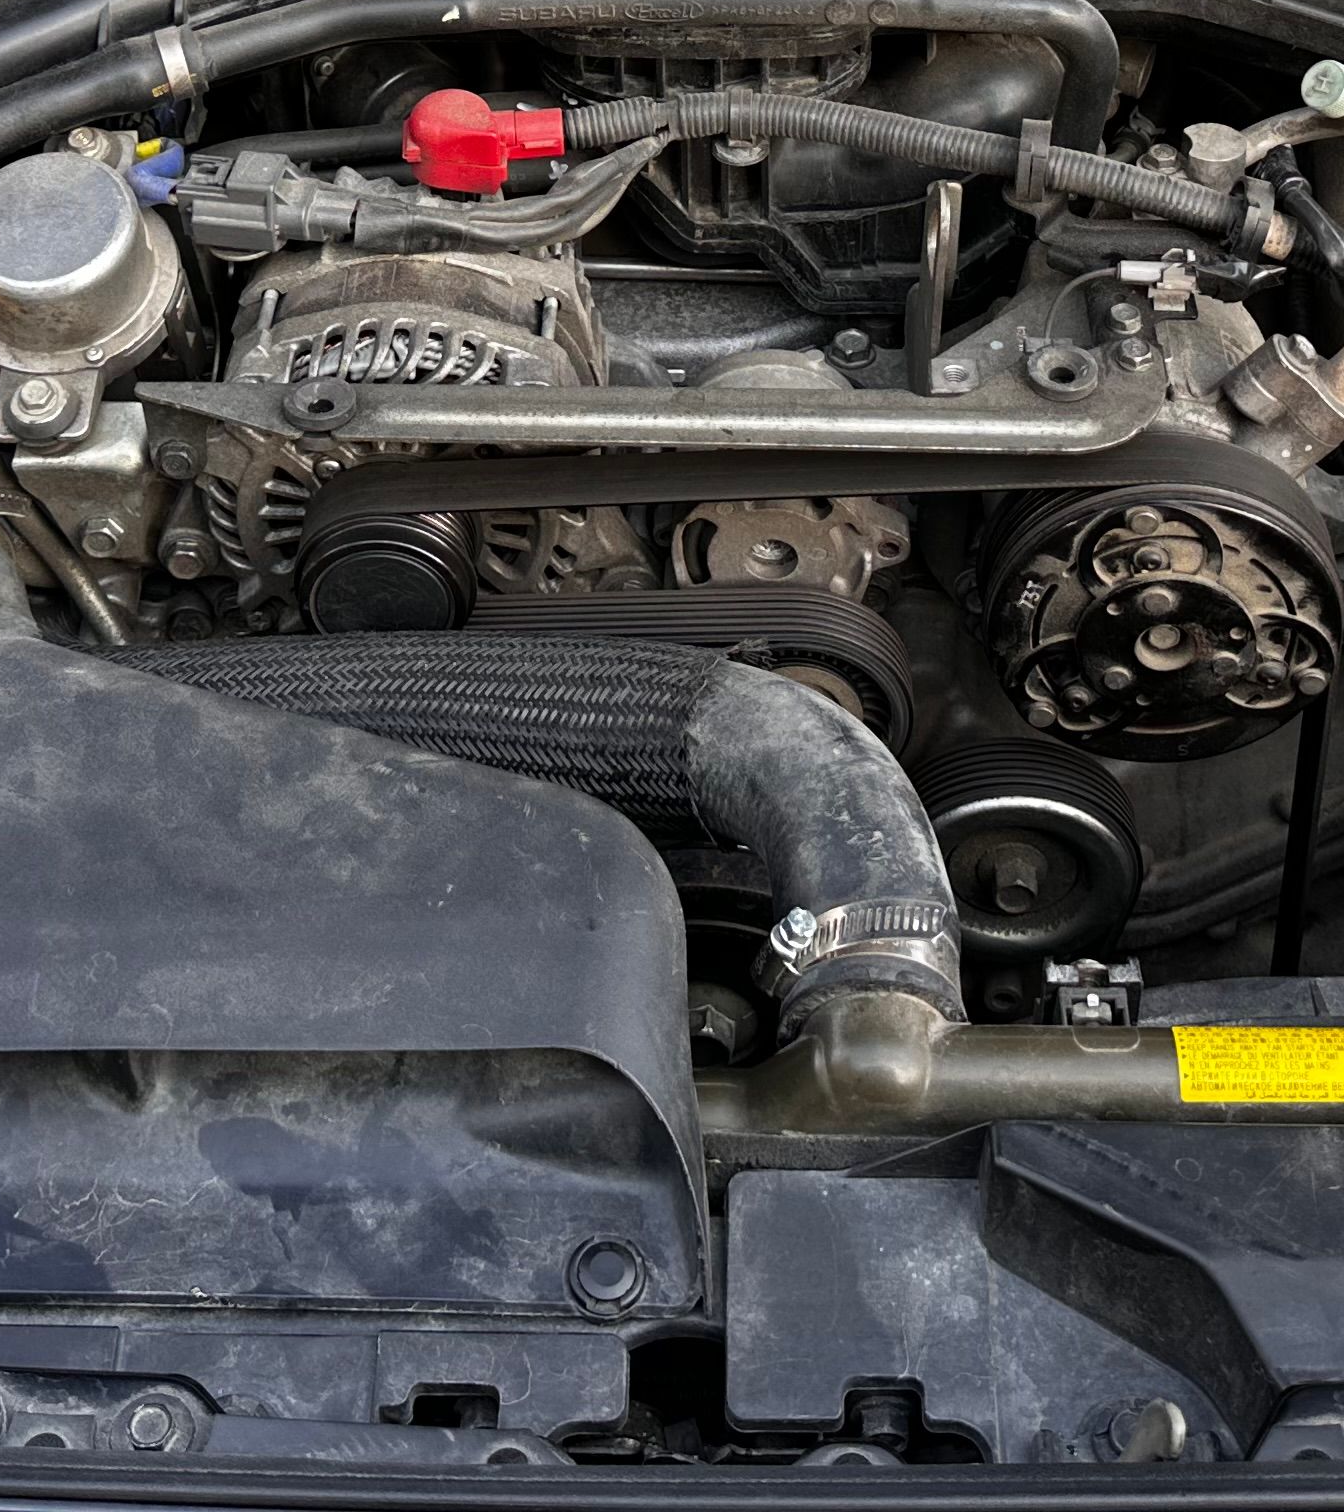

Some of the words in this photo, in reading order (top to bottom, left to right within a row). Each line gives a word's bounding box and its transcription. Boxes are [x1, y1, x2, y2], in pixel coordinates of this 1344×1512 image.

[498, 3, 617, 21] SUBARU
[1247, 1051, 1259, 1060] DU
[1261, 1051, 1312, 1060] VENTILATEUR
[1214, 1061, 1259, 1069] APPROCHEZ
[1264, 1061, 1280, 1069] PAS
[1285, 1061, 1299, 1070] LES
[1191, 1082, 1272, 1091] АВТОМАТИЧЕСКОЕ
[1275, 1082, 1329, 1091] ВКЛЮЧЕНИЕ
